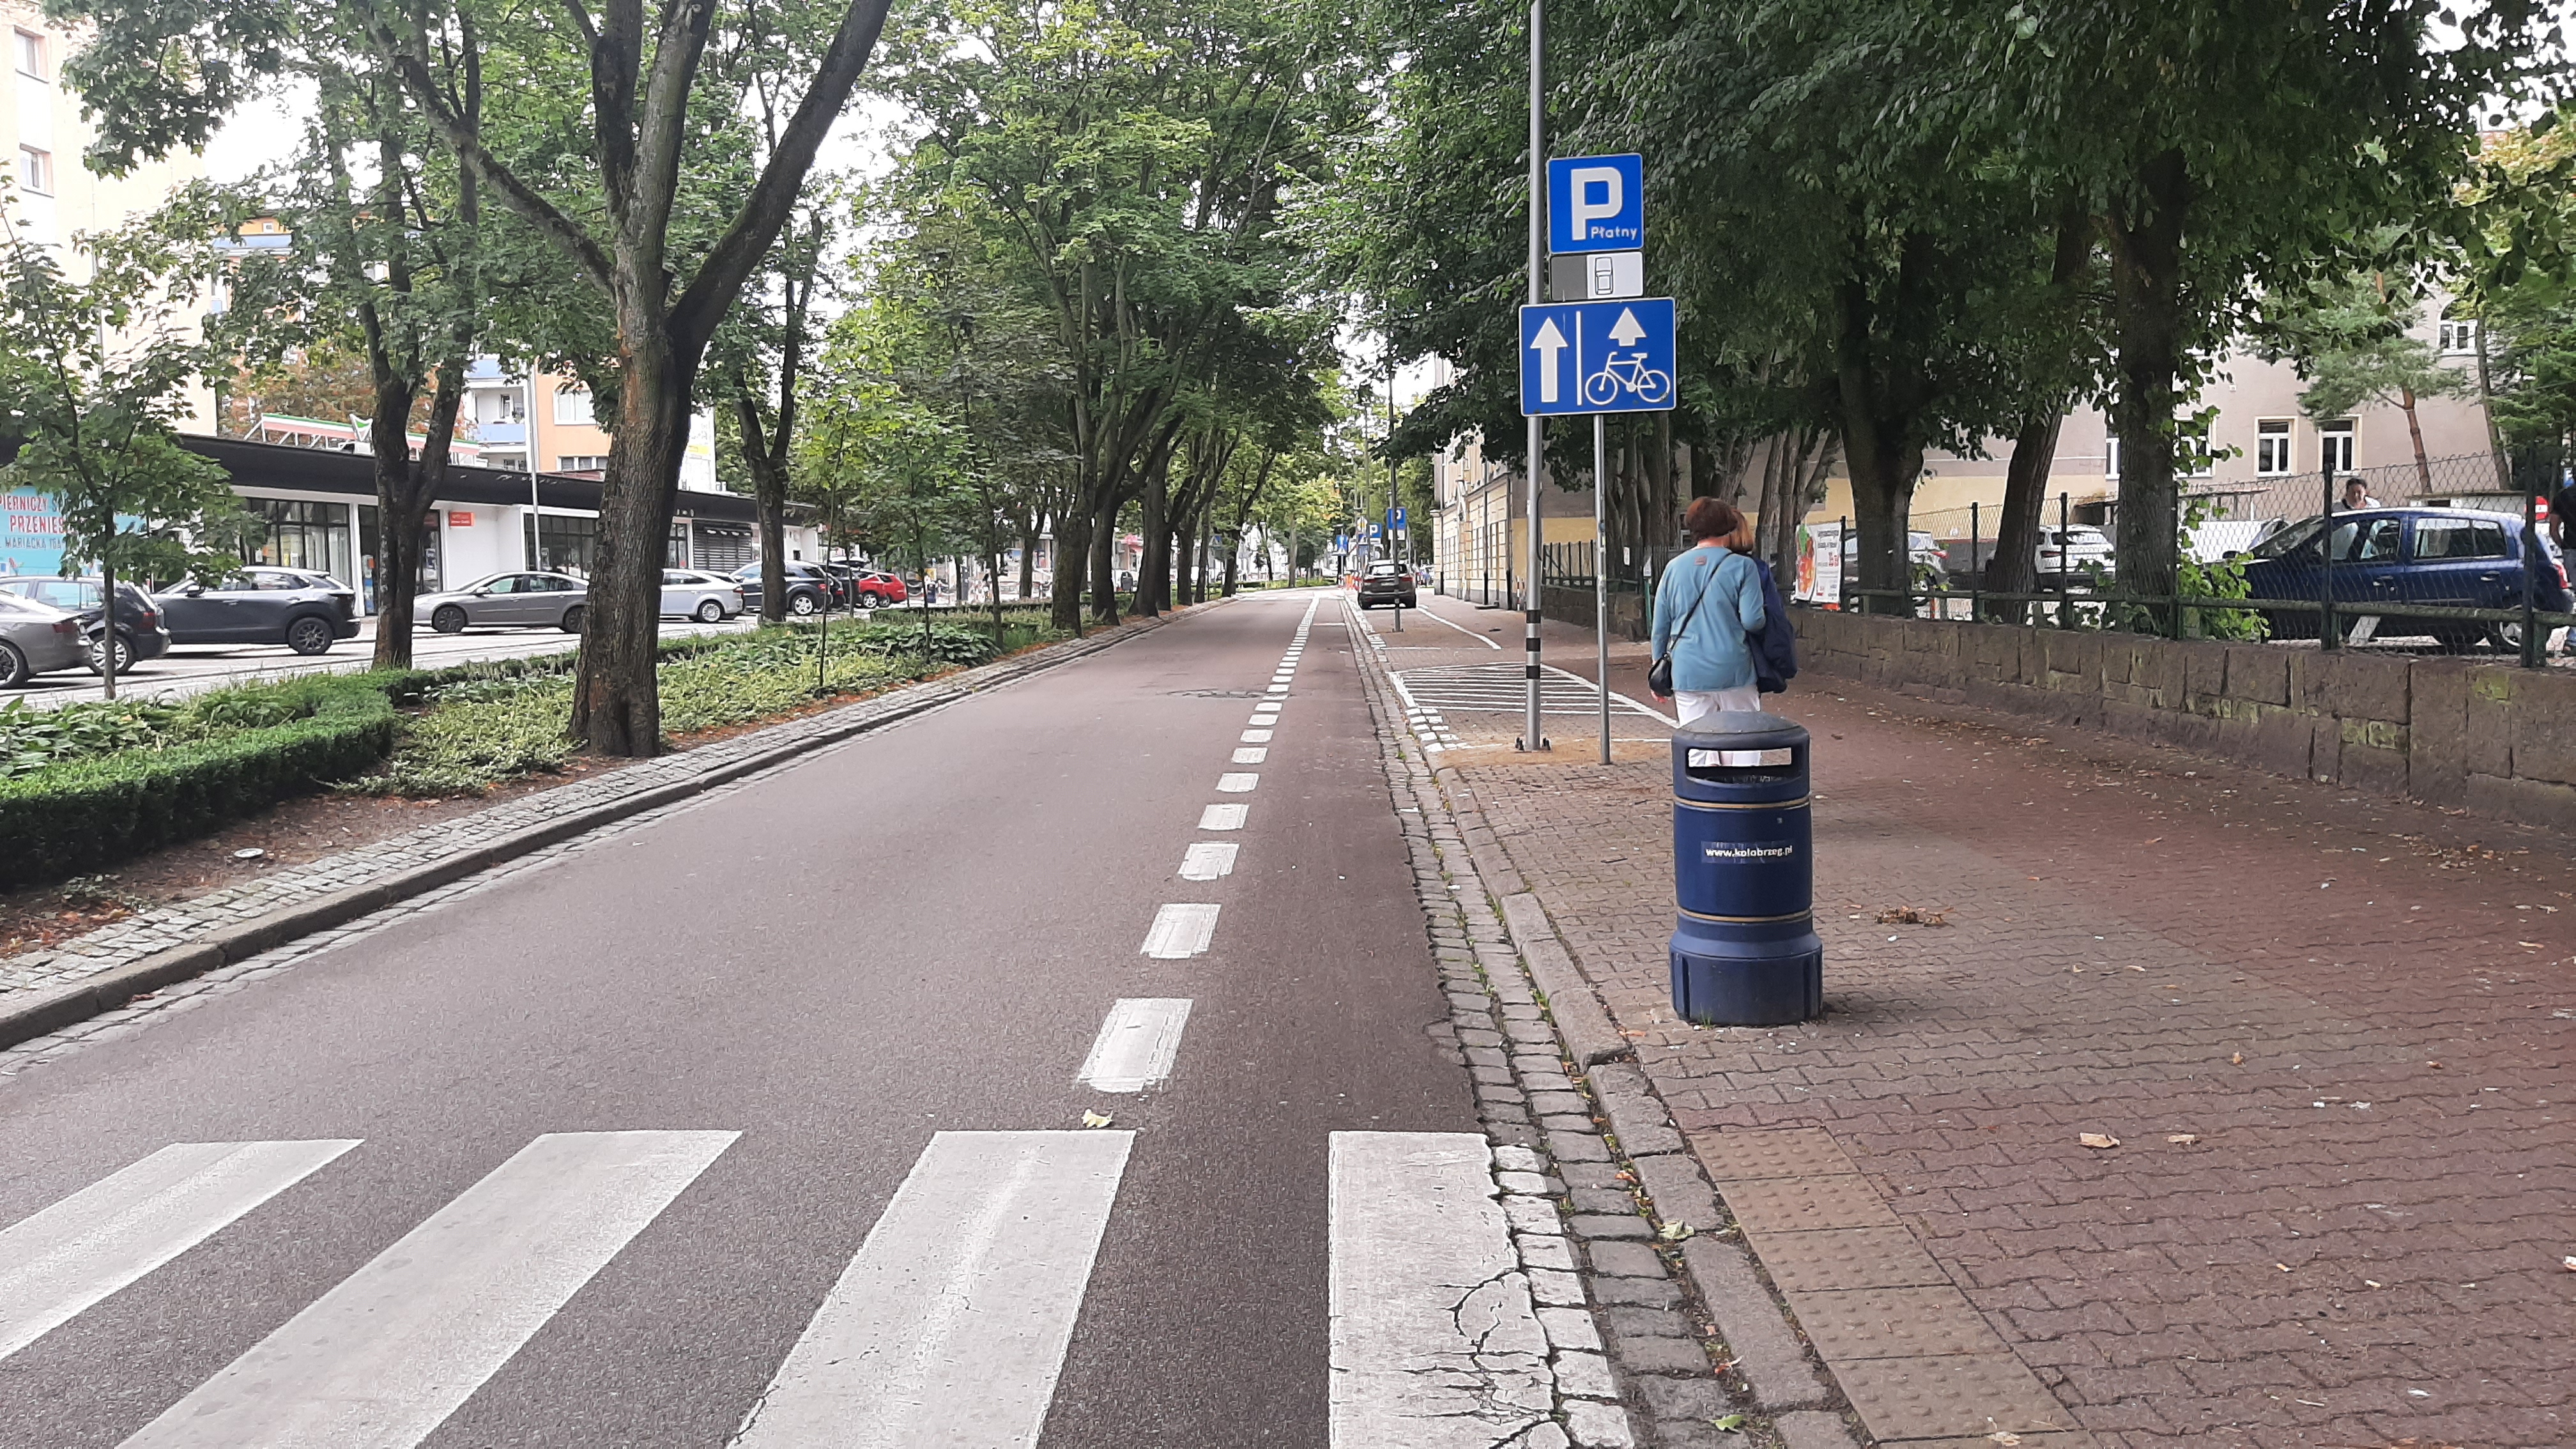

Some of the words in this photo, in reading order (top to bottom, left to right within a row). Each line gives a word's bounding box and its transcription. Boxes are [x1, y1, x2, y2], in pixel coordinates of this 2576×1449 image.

[1571, 167, 1623, 241] P
[1591, 226, 1637, 240] Płatny
[10, 515, 65, 533] PRZENIES
[1369, 525, 1378, 535] P
[1706, 845, 1793, 857] www.kolobrzeg.pl
